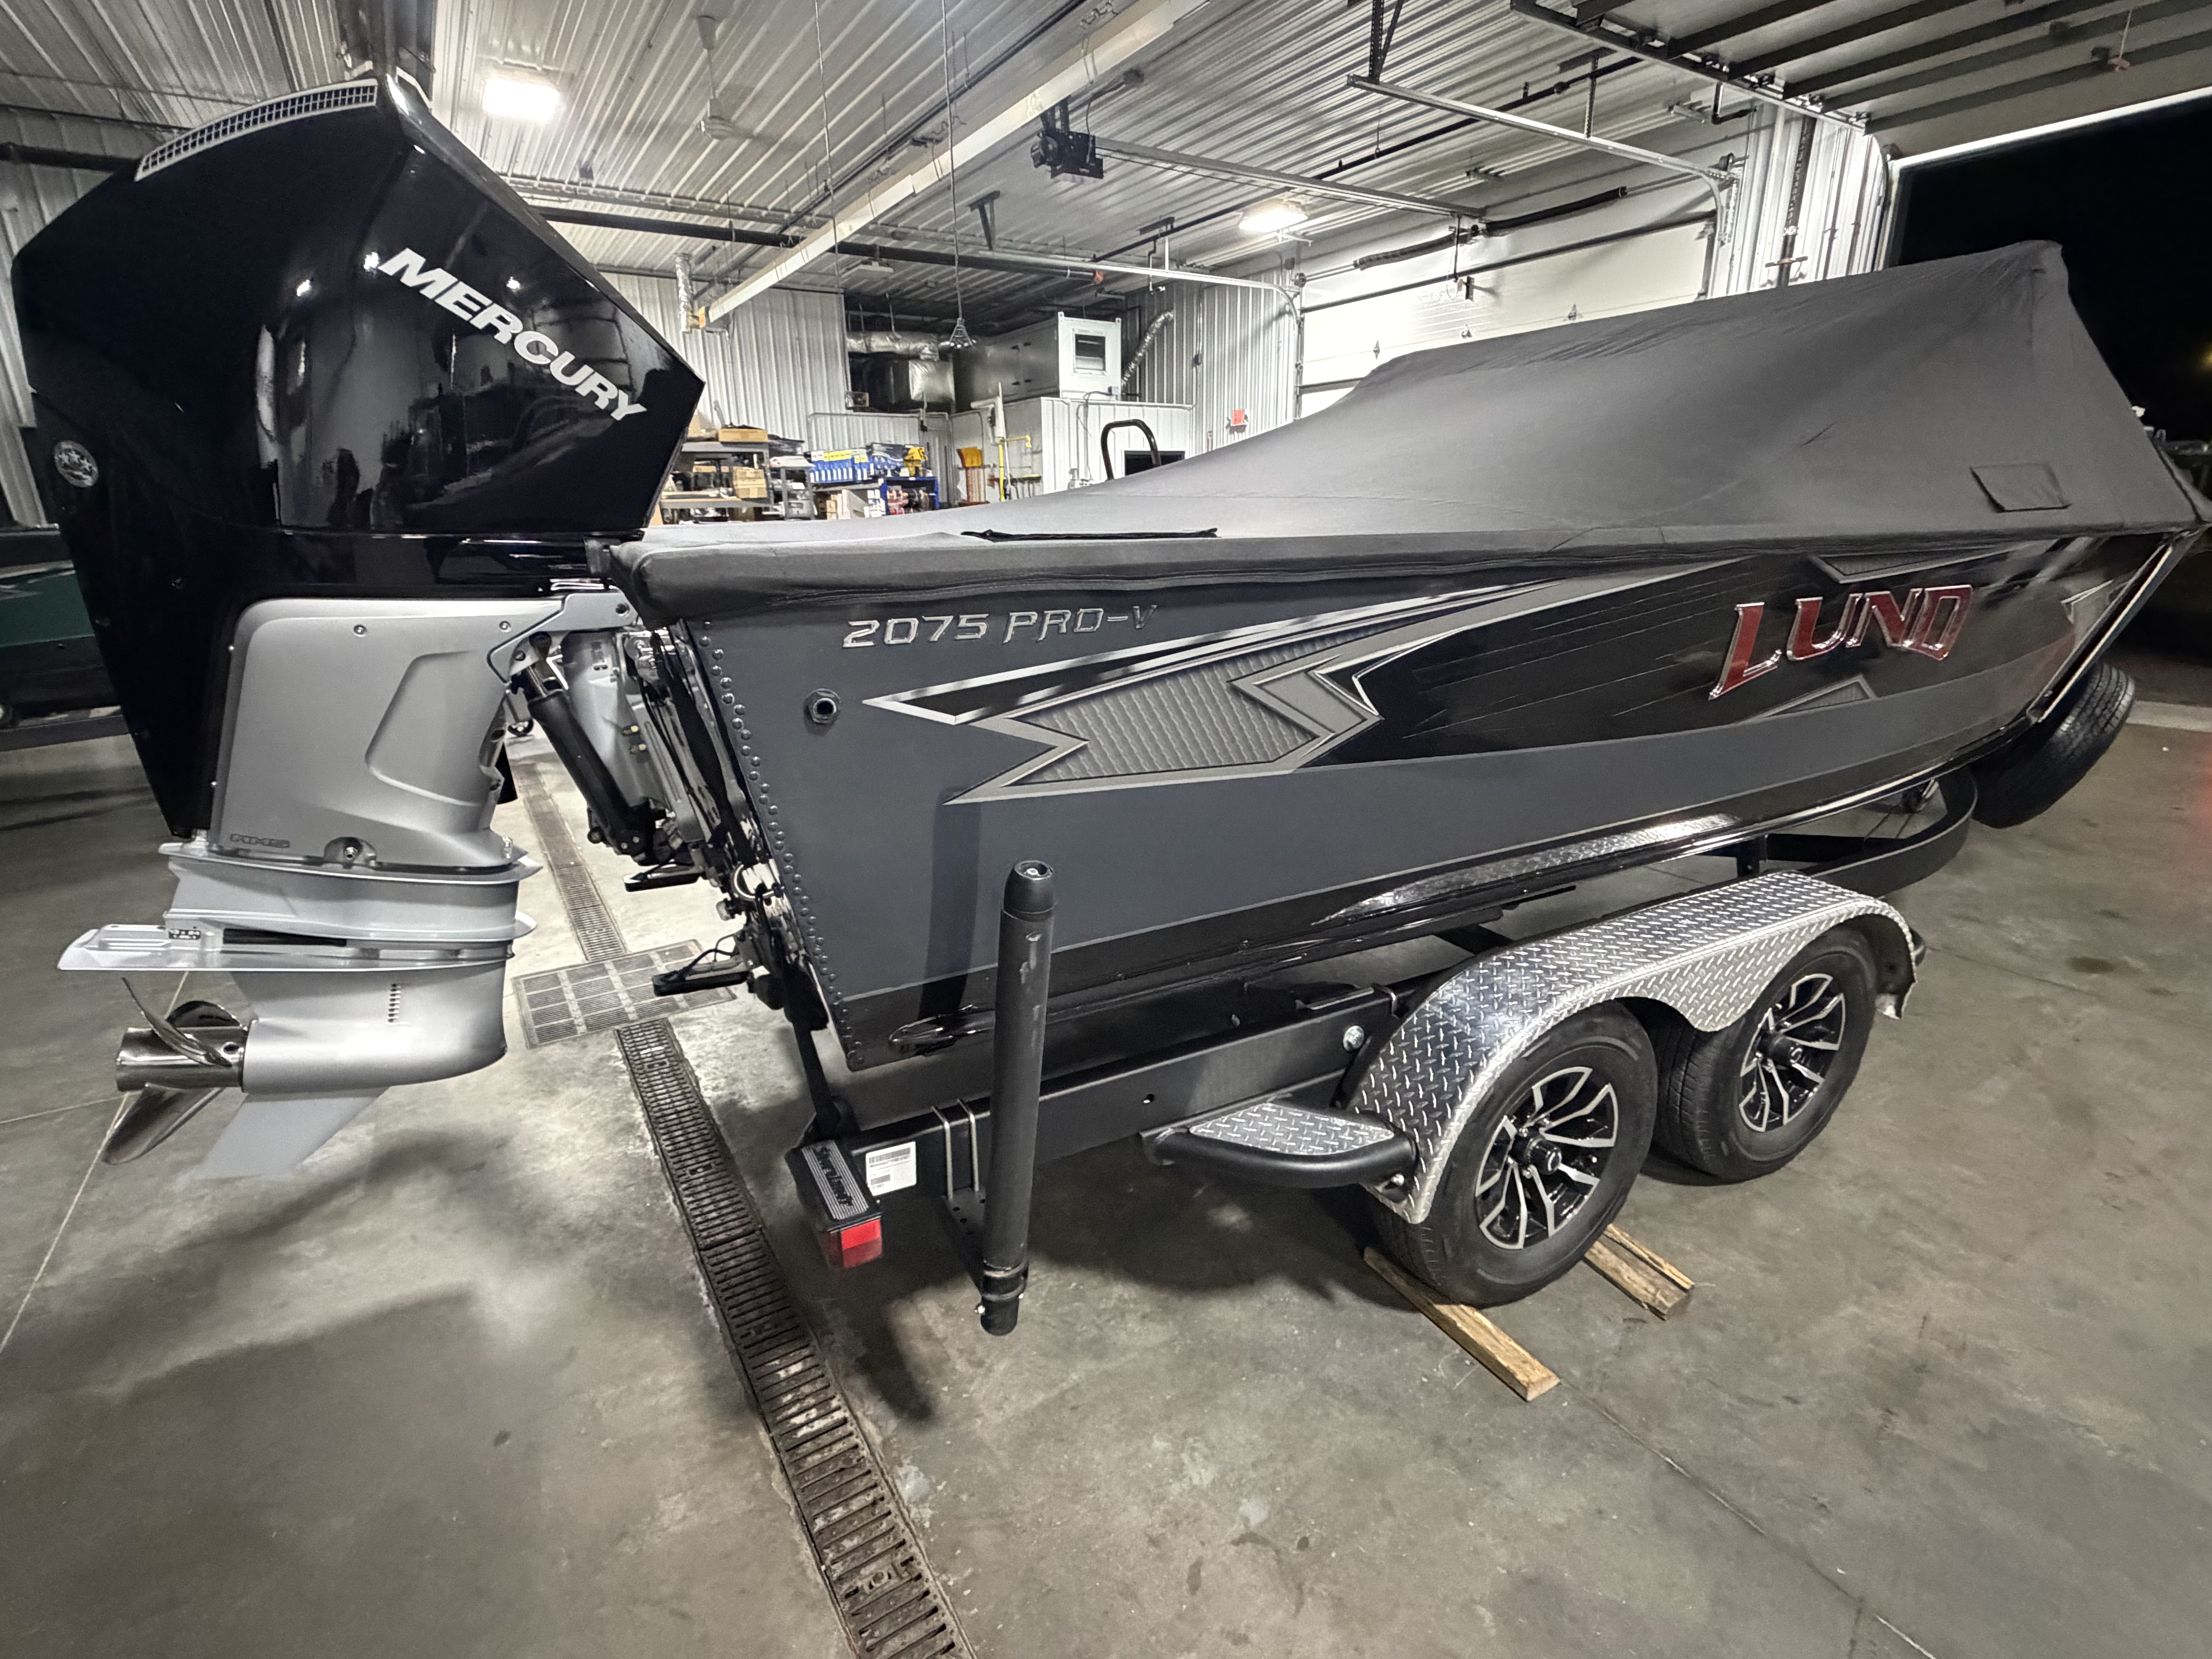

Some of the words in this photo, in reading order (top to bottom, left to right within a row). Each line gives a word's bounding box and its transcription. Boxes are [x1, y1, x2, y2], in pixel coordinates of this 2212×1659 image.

[378, 247, 647, 421] MERCURY
[842, 613, 990, 648] 2075
[1002, 604, 1158, 645] PRO-V
[1708, 584, 1974, 701] LUND
